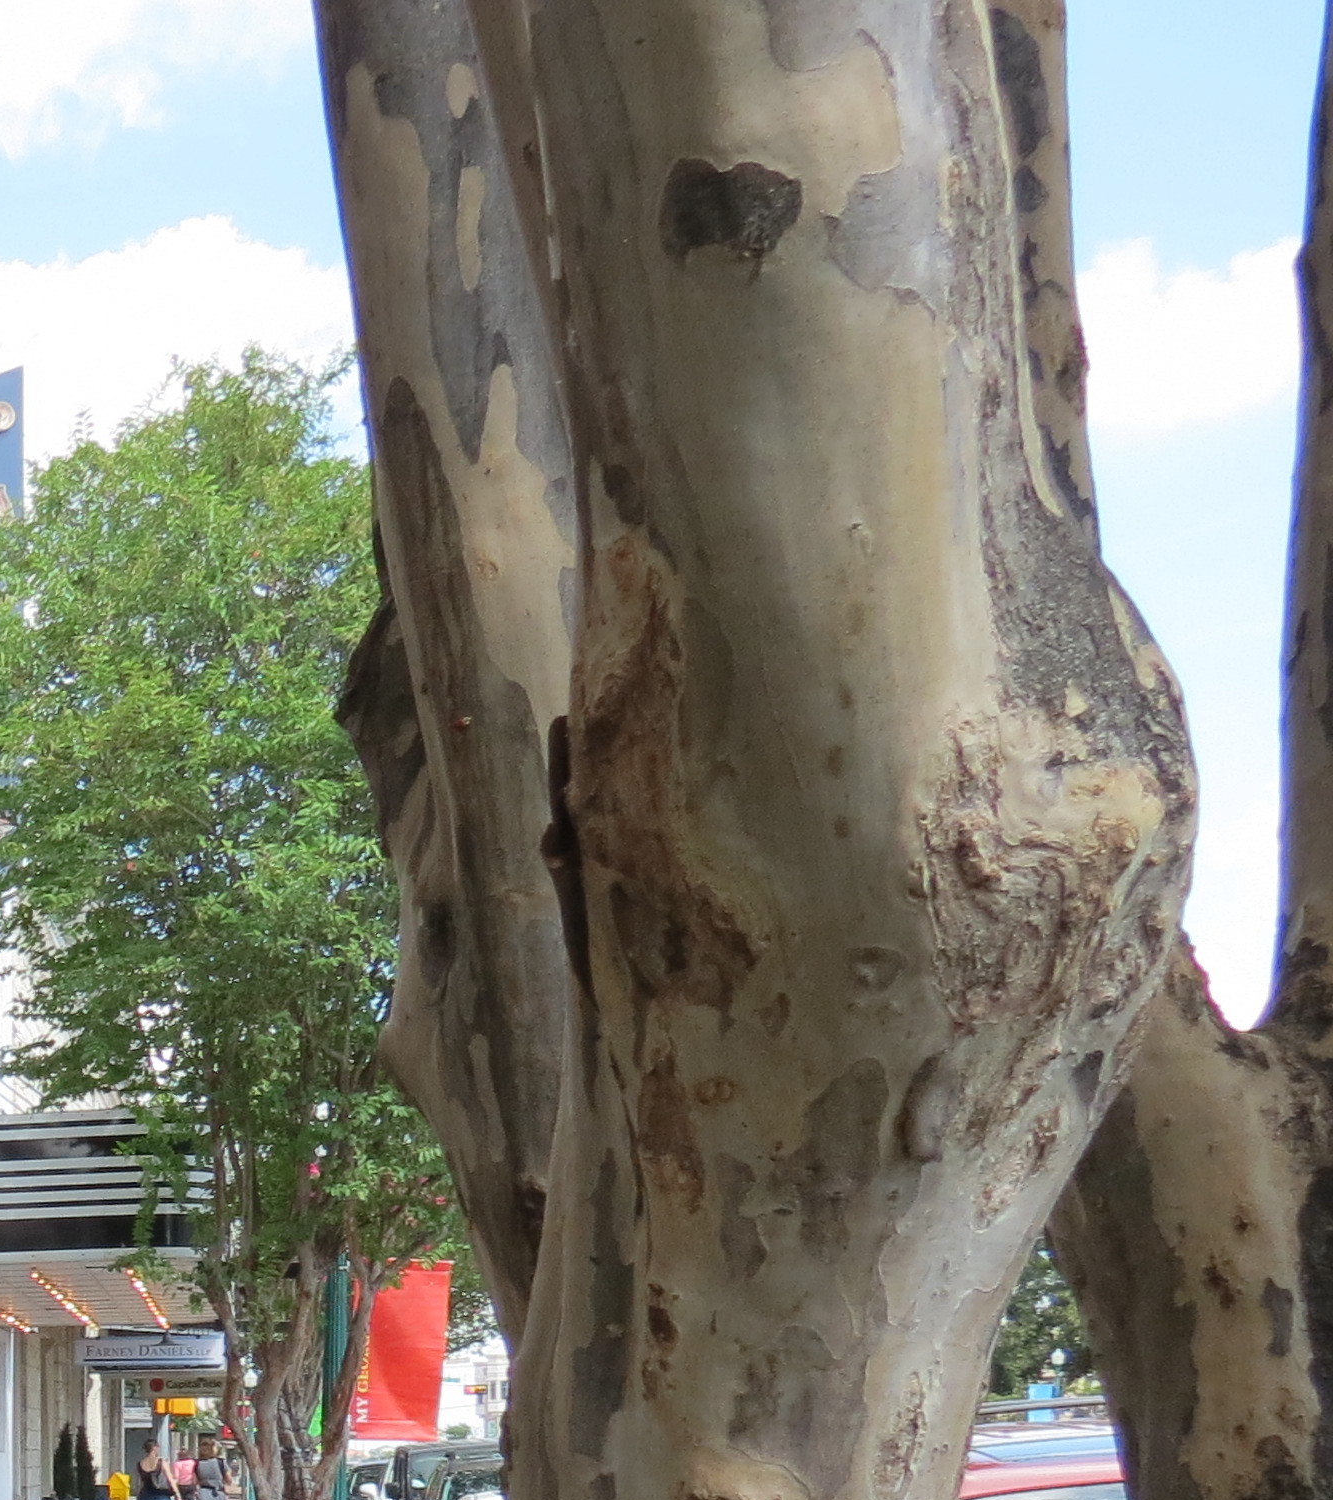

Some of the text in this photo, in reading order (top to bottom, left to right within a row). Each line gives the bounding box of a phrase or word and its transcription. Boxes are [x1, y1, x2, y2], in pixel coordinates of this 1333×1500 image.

[85, 1344, 134, 1358] FARNEY
[138, 1344, 193, 1357] DANIELS
[355, 1396, 369, 1423] MY
